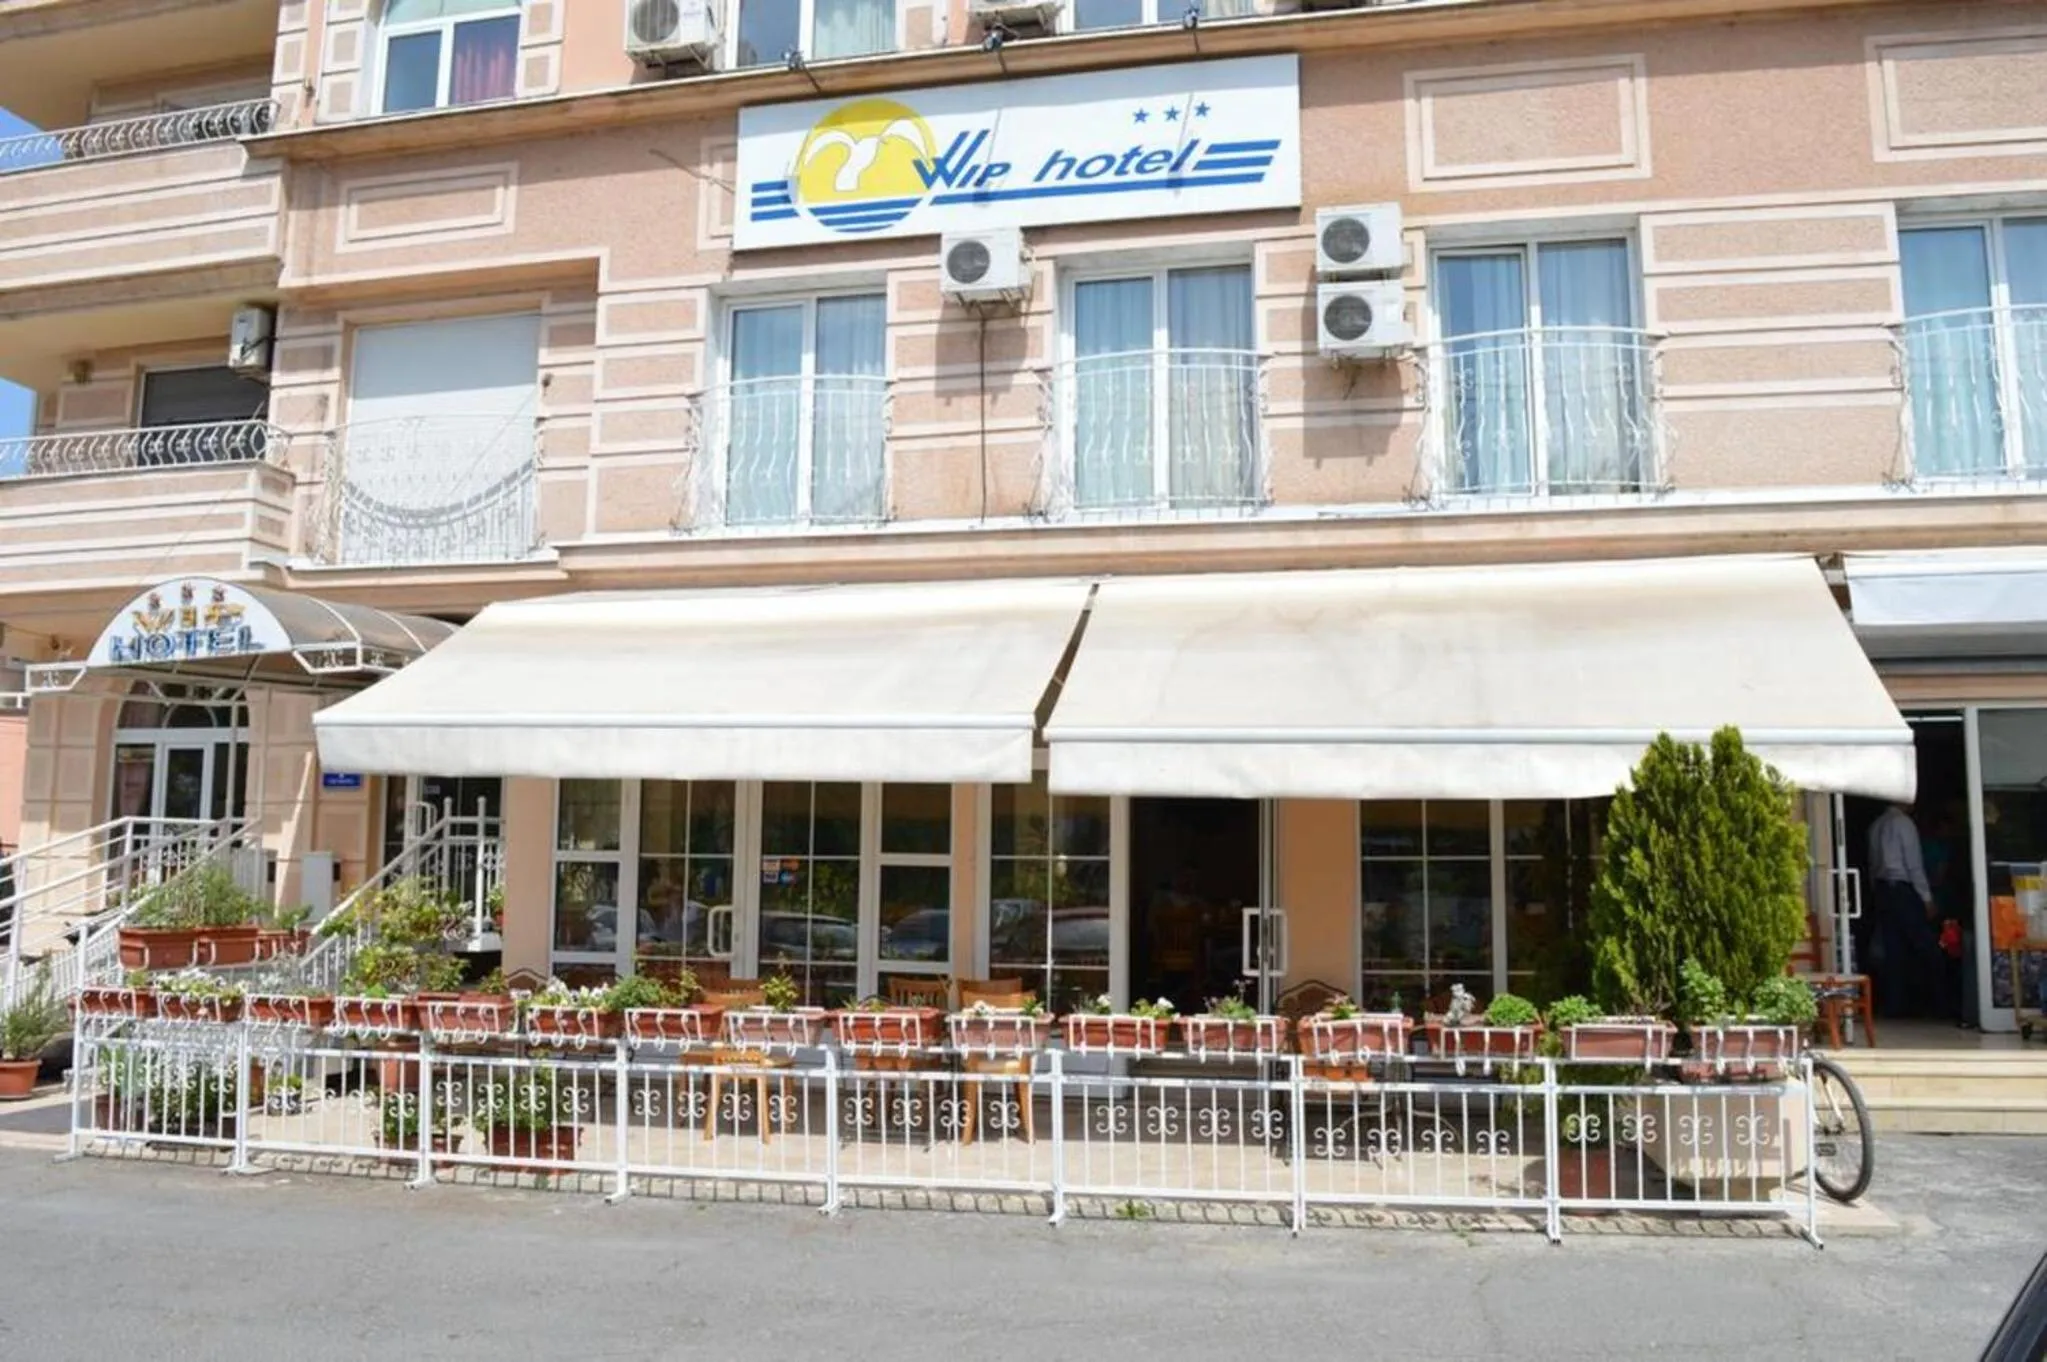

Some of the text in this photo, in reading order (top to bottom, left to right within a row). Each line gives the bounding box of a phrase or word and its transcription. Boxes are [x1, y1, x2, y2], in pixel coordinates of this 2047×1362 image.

[1034, 139, 1199, 182] hotel
[132, 603, 247, 632] VIP
[110, 626, 265, 662] HOTEL
